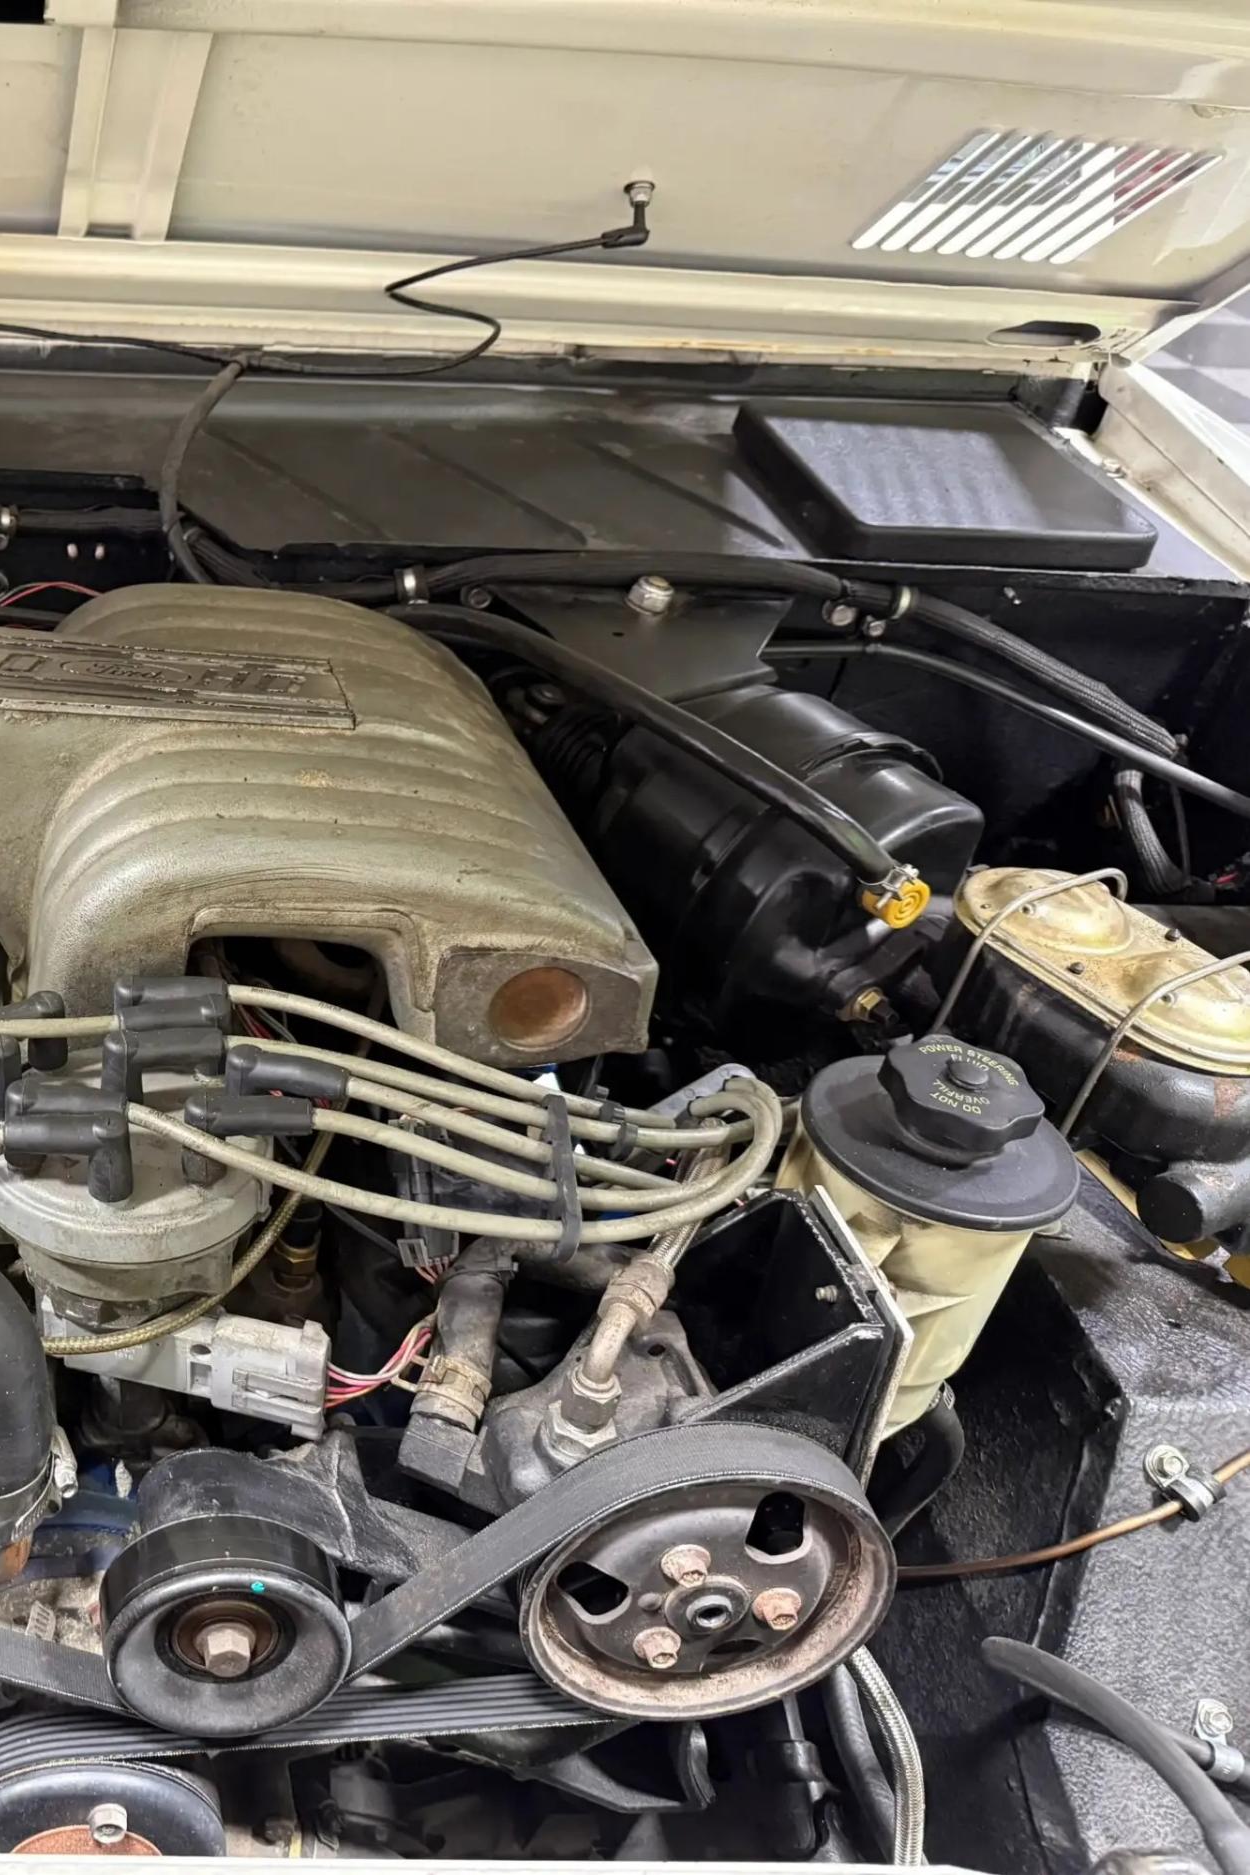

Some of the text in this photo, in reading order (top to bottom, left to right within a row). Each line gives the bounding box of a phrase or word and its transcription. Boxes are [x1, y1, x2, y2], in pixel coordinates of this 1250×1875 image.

[86, 660, 168, 684] Ford
[918, 1043, 1019, 1089] POWER STEERING
[930, 1092, 982, 1115] DO NOT
[933, 1078, 991, 1105] OVERFILL
